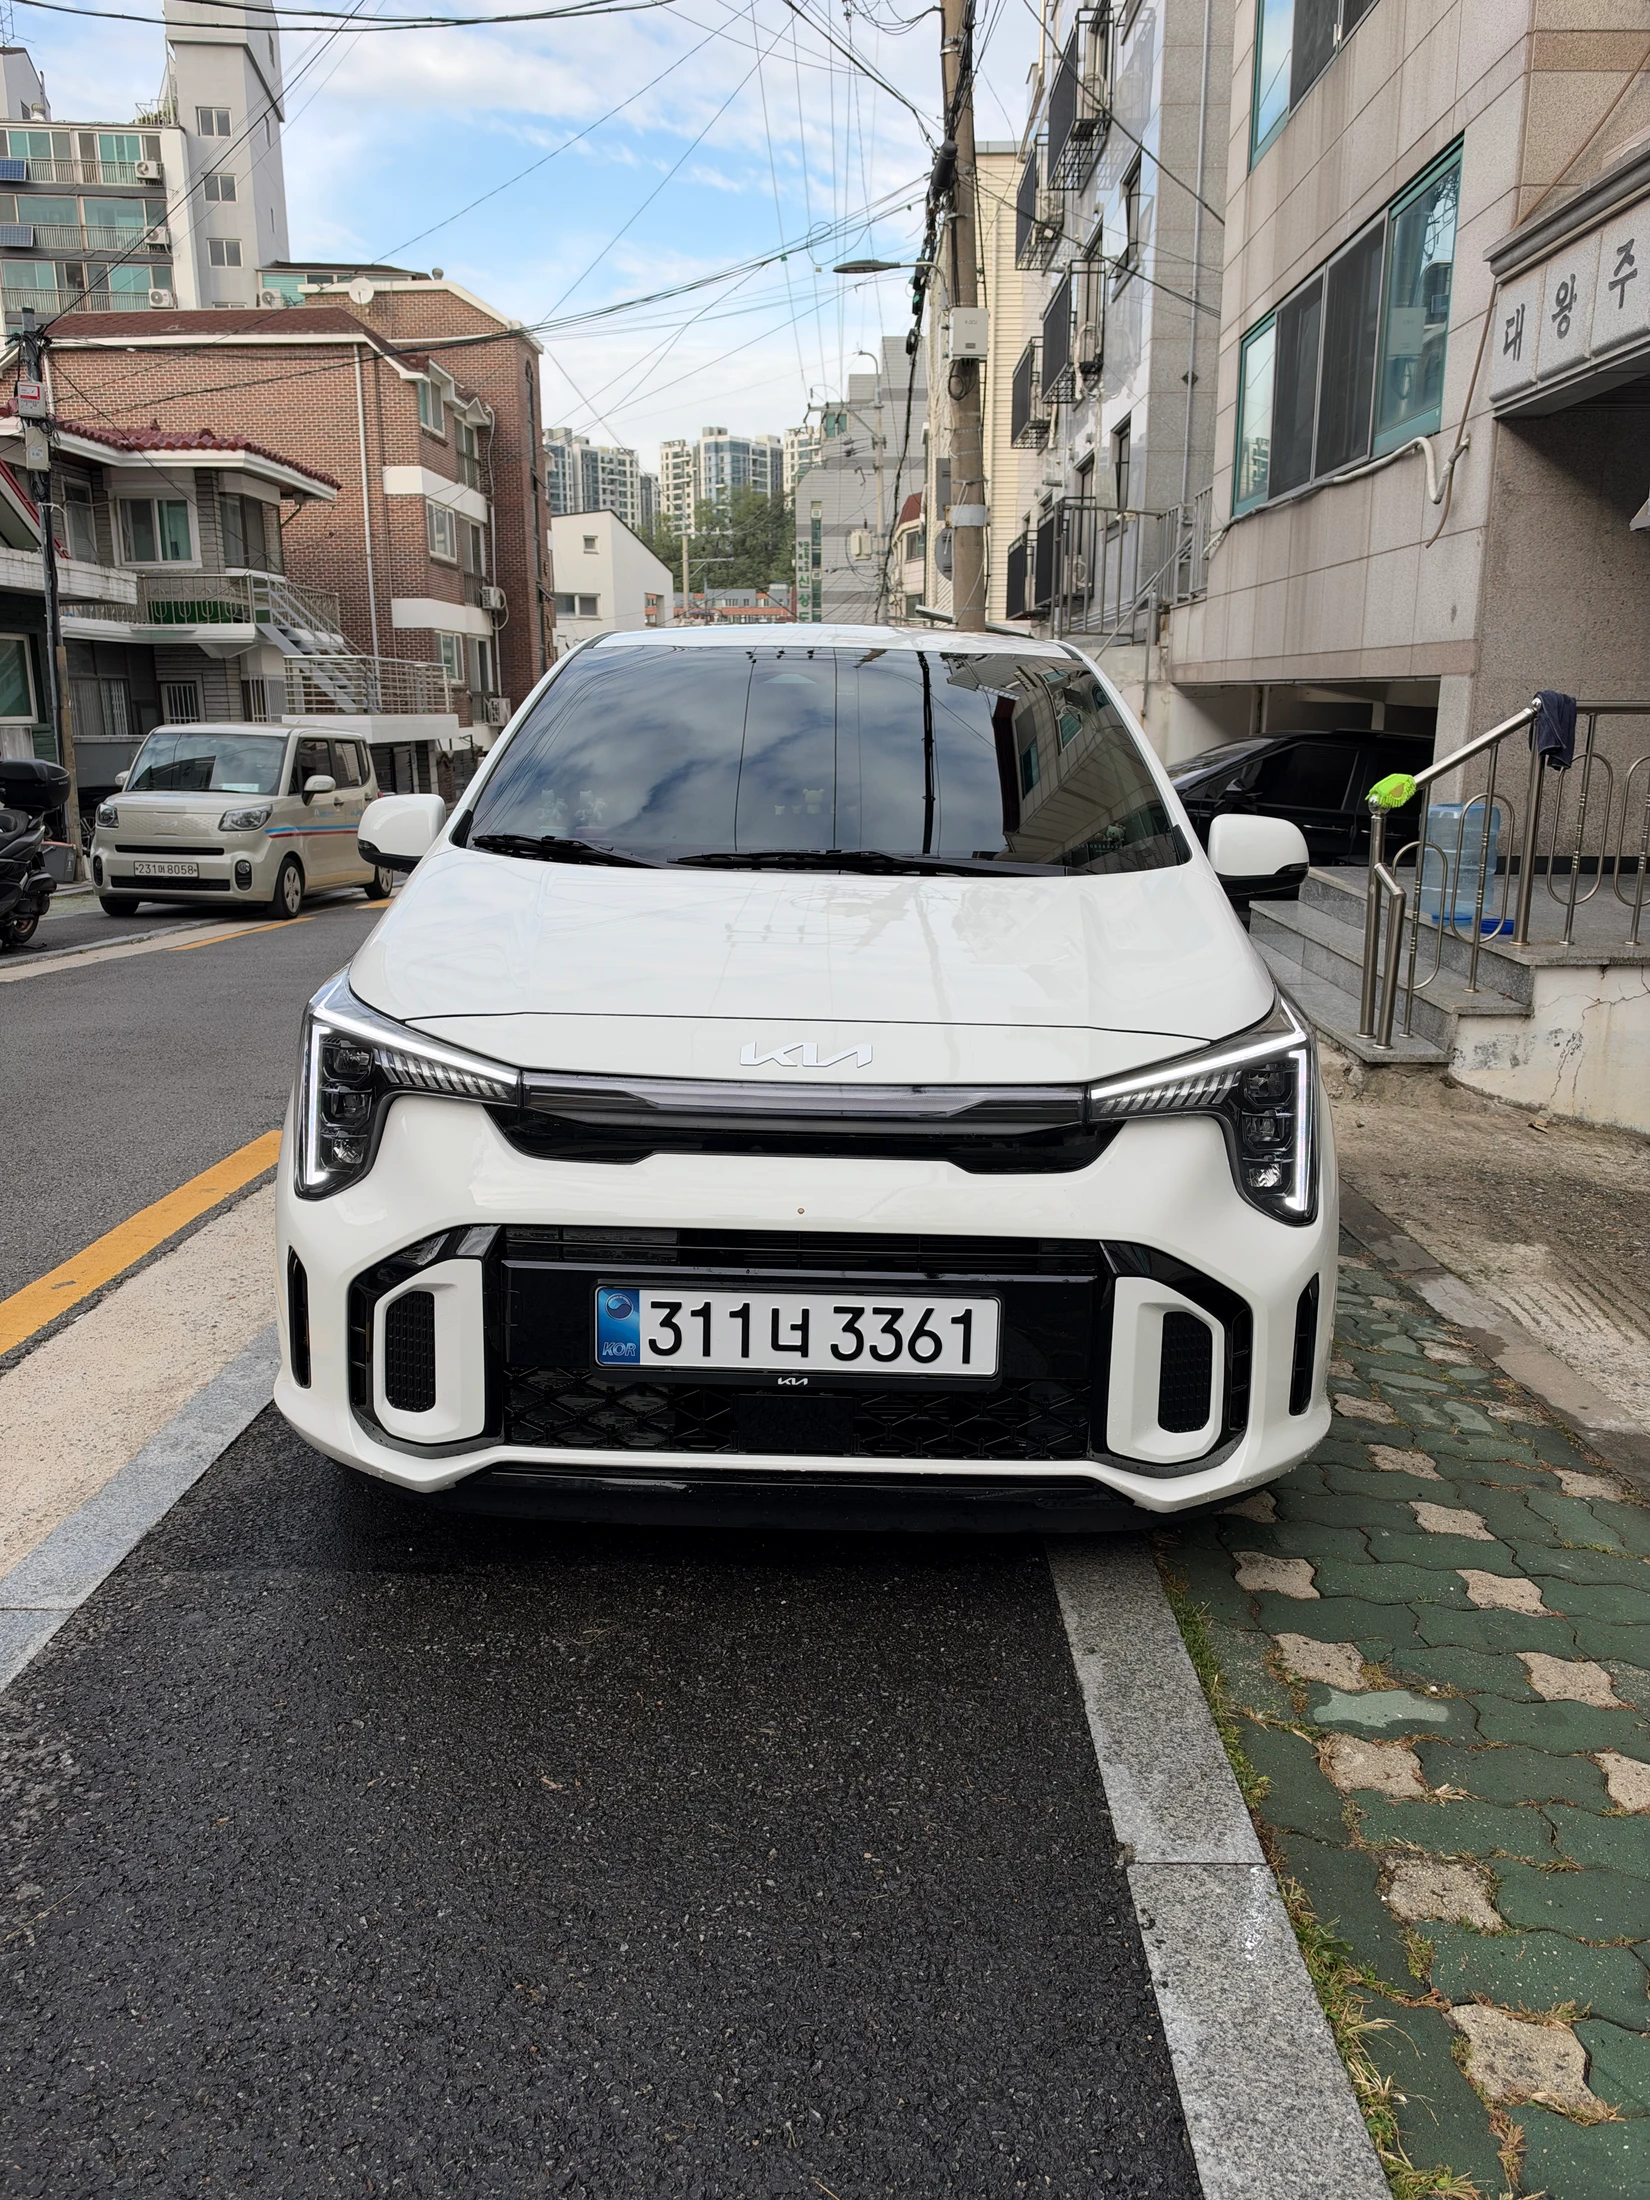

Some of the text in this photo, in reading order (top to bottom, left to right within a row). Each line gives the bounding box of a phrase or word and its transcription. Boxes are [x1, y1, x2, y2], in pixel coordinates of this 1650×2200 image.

[740, 1041, 873, 1068] KIA
[830, 1306, 973, 1364] 3361
[602, 1341, 637, 1357] KOR
[777, 1377, 808, 1386] KIA
